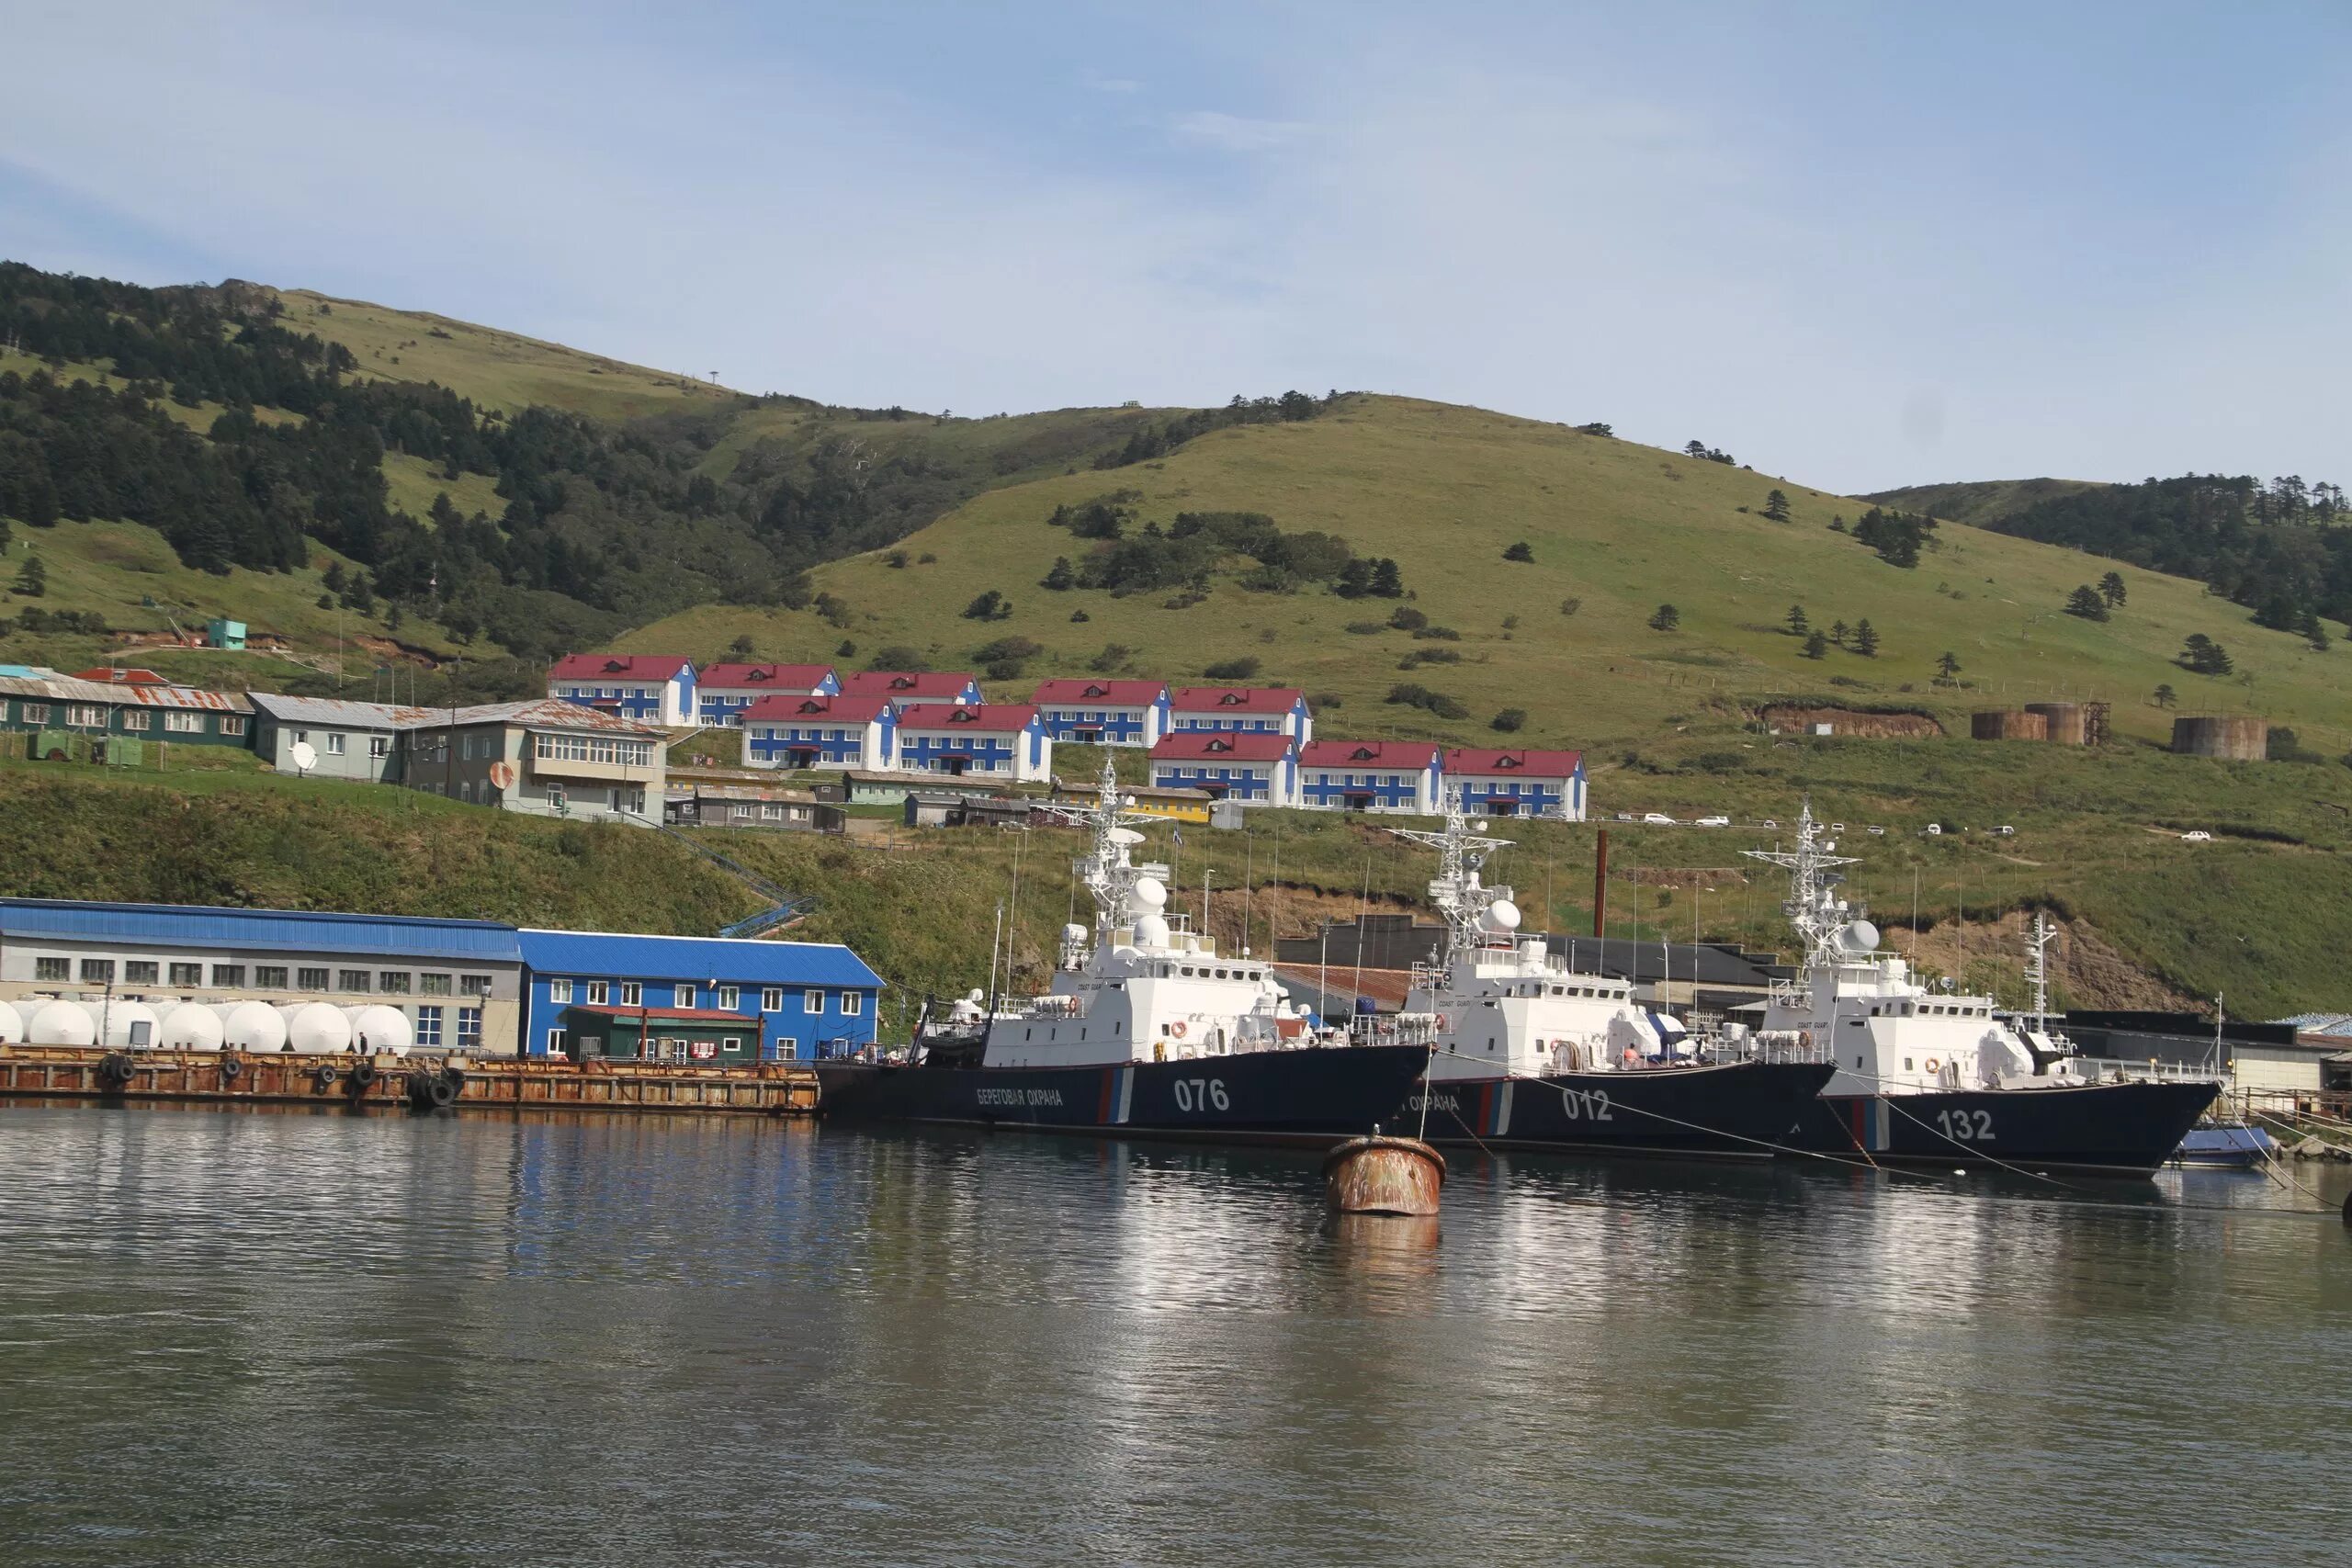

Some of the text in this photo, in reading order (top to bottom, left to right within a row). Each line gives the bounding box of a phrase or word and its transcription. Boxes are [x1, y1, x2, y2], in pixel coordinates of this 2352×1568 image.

[976, 1088, 1064, 1106] БЕРЕГОВАЯ ОХРАНА
[1174, 1078, 1230, 1112] 076
[1409, 1095, 1460, 1111] ОХРАНА
[1562, 1089, 1613, 1121] 012
[1936, 1109, 1996, 1140] 132
